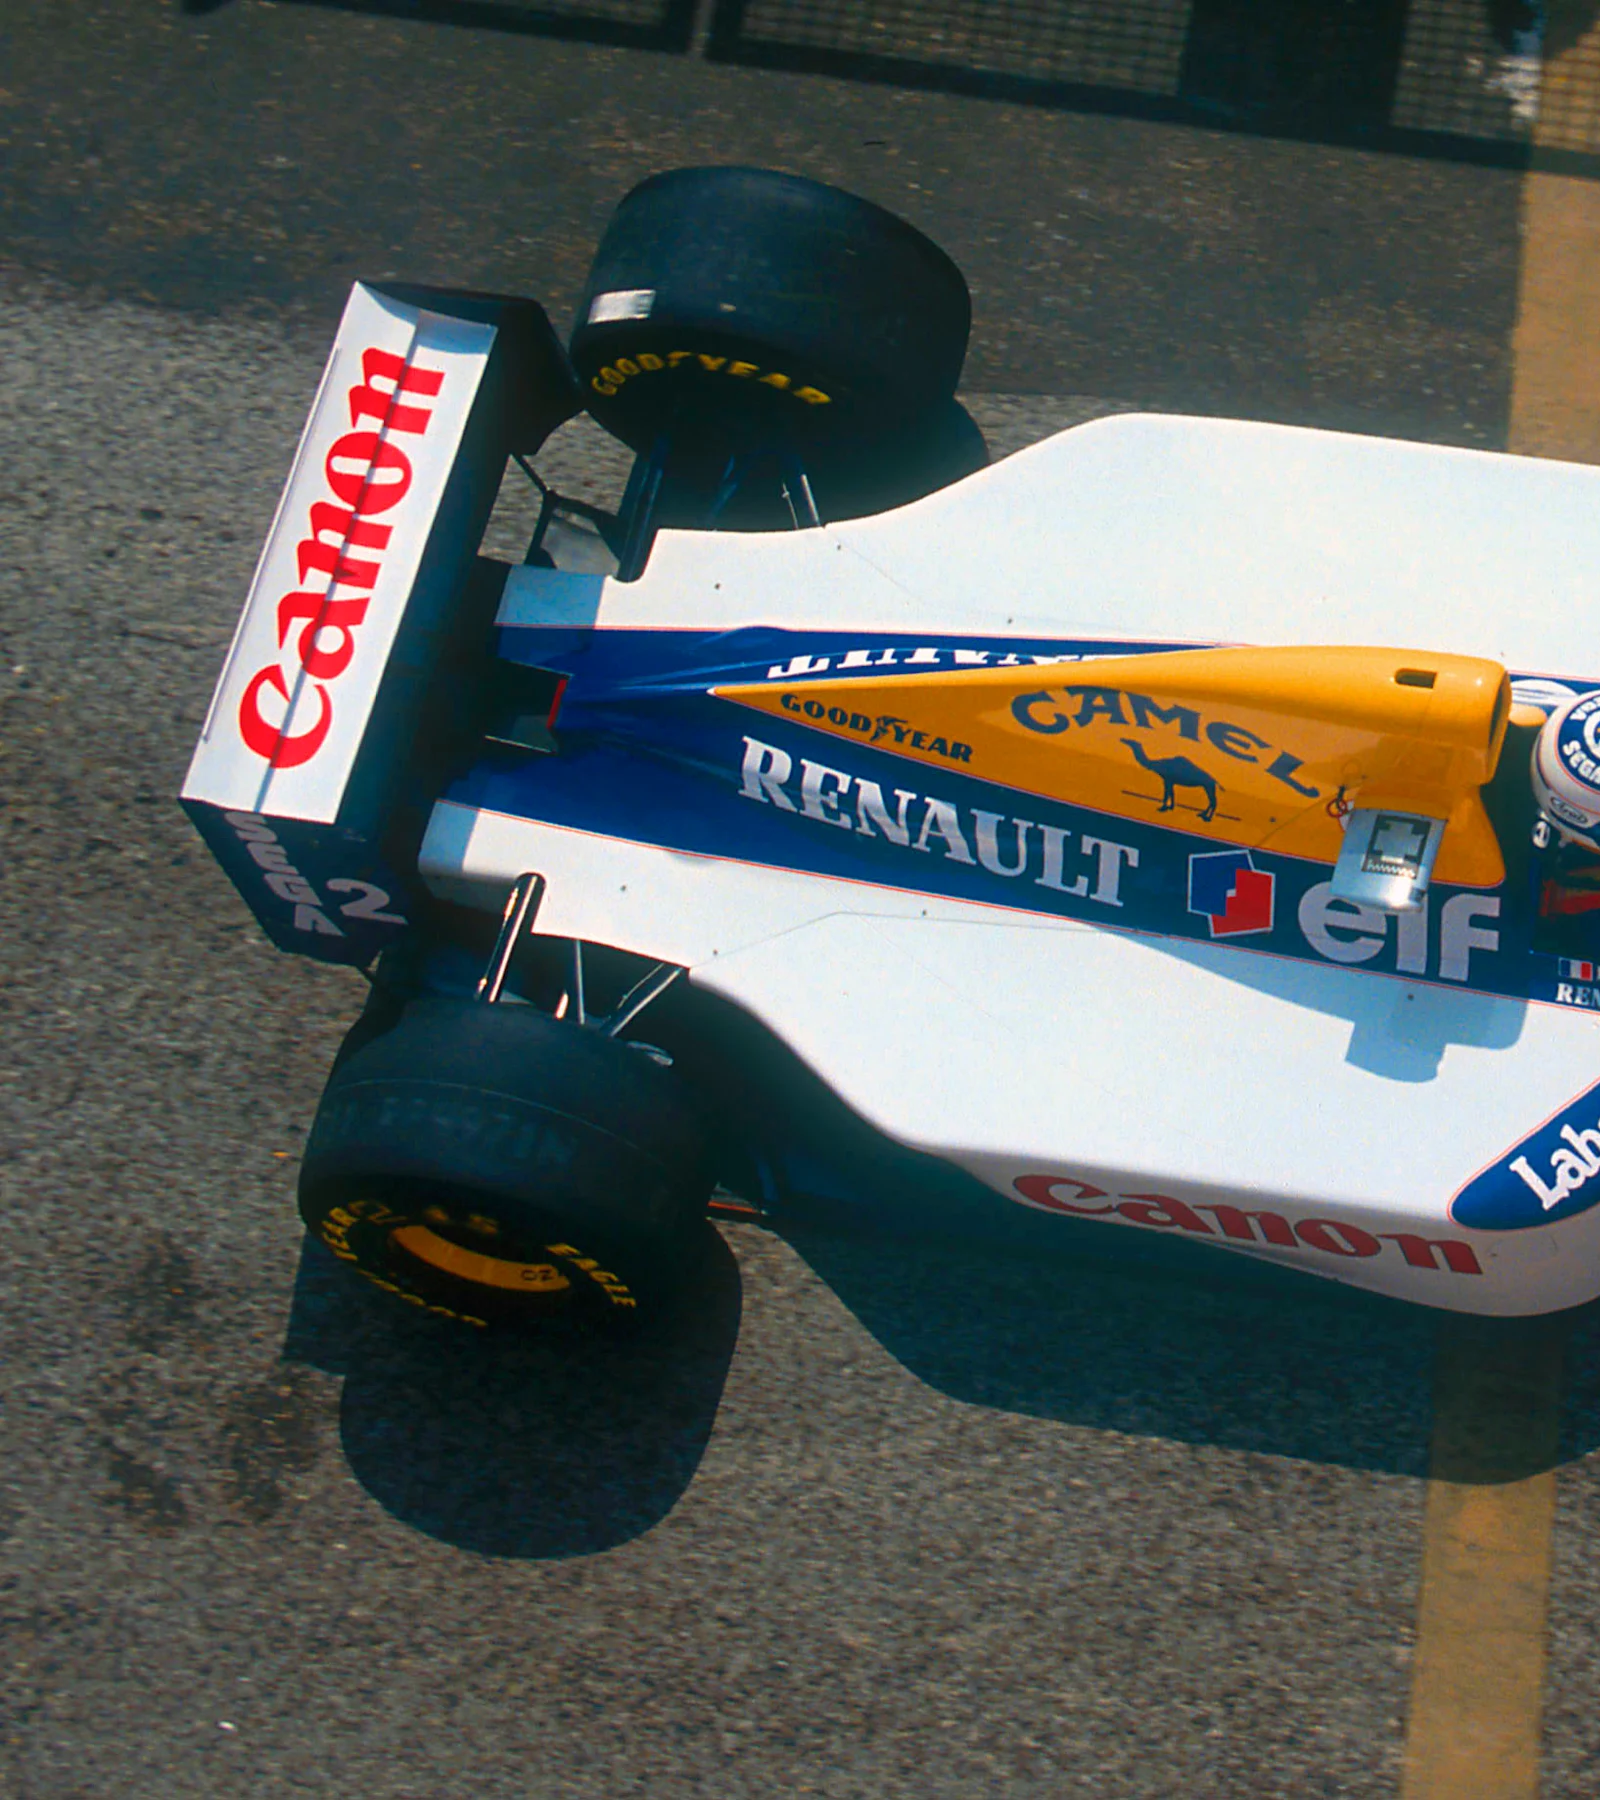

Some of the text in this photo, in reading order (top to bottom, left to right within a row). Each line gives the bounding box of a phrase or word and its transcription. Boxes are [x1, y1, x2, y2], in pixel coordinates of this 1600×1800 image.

[239, 347, 445, 768] Canon
[781, 693, 973, 763] GOODYEAR
[1011, 686, 1320, 798] CAMEL
[225, 812, 345, 936] SEGA
[738, 736, 1139, 906] RENAULT
[327, 878, 408, 925] 2
[1298, 880, 1499, 982] elf
[1013, 1174, 1483, 1275] Canon
